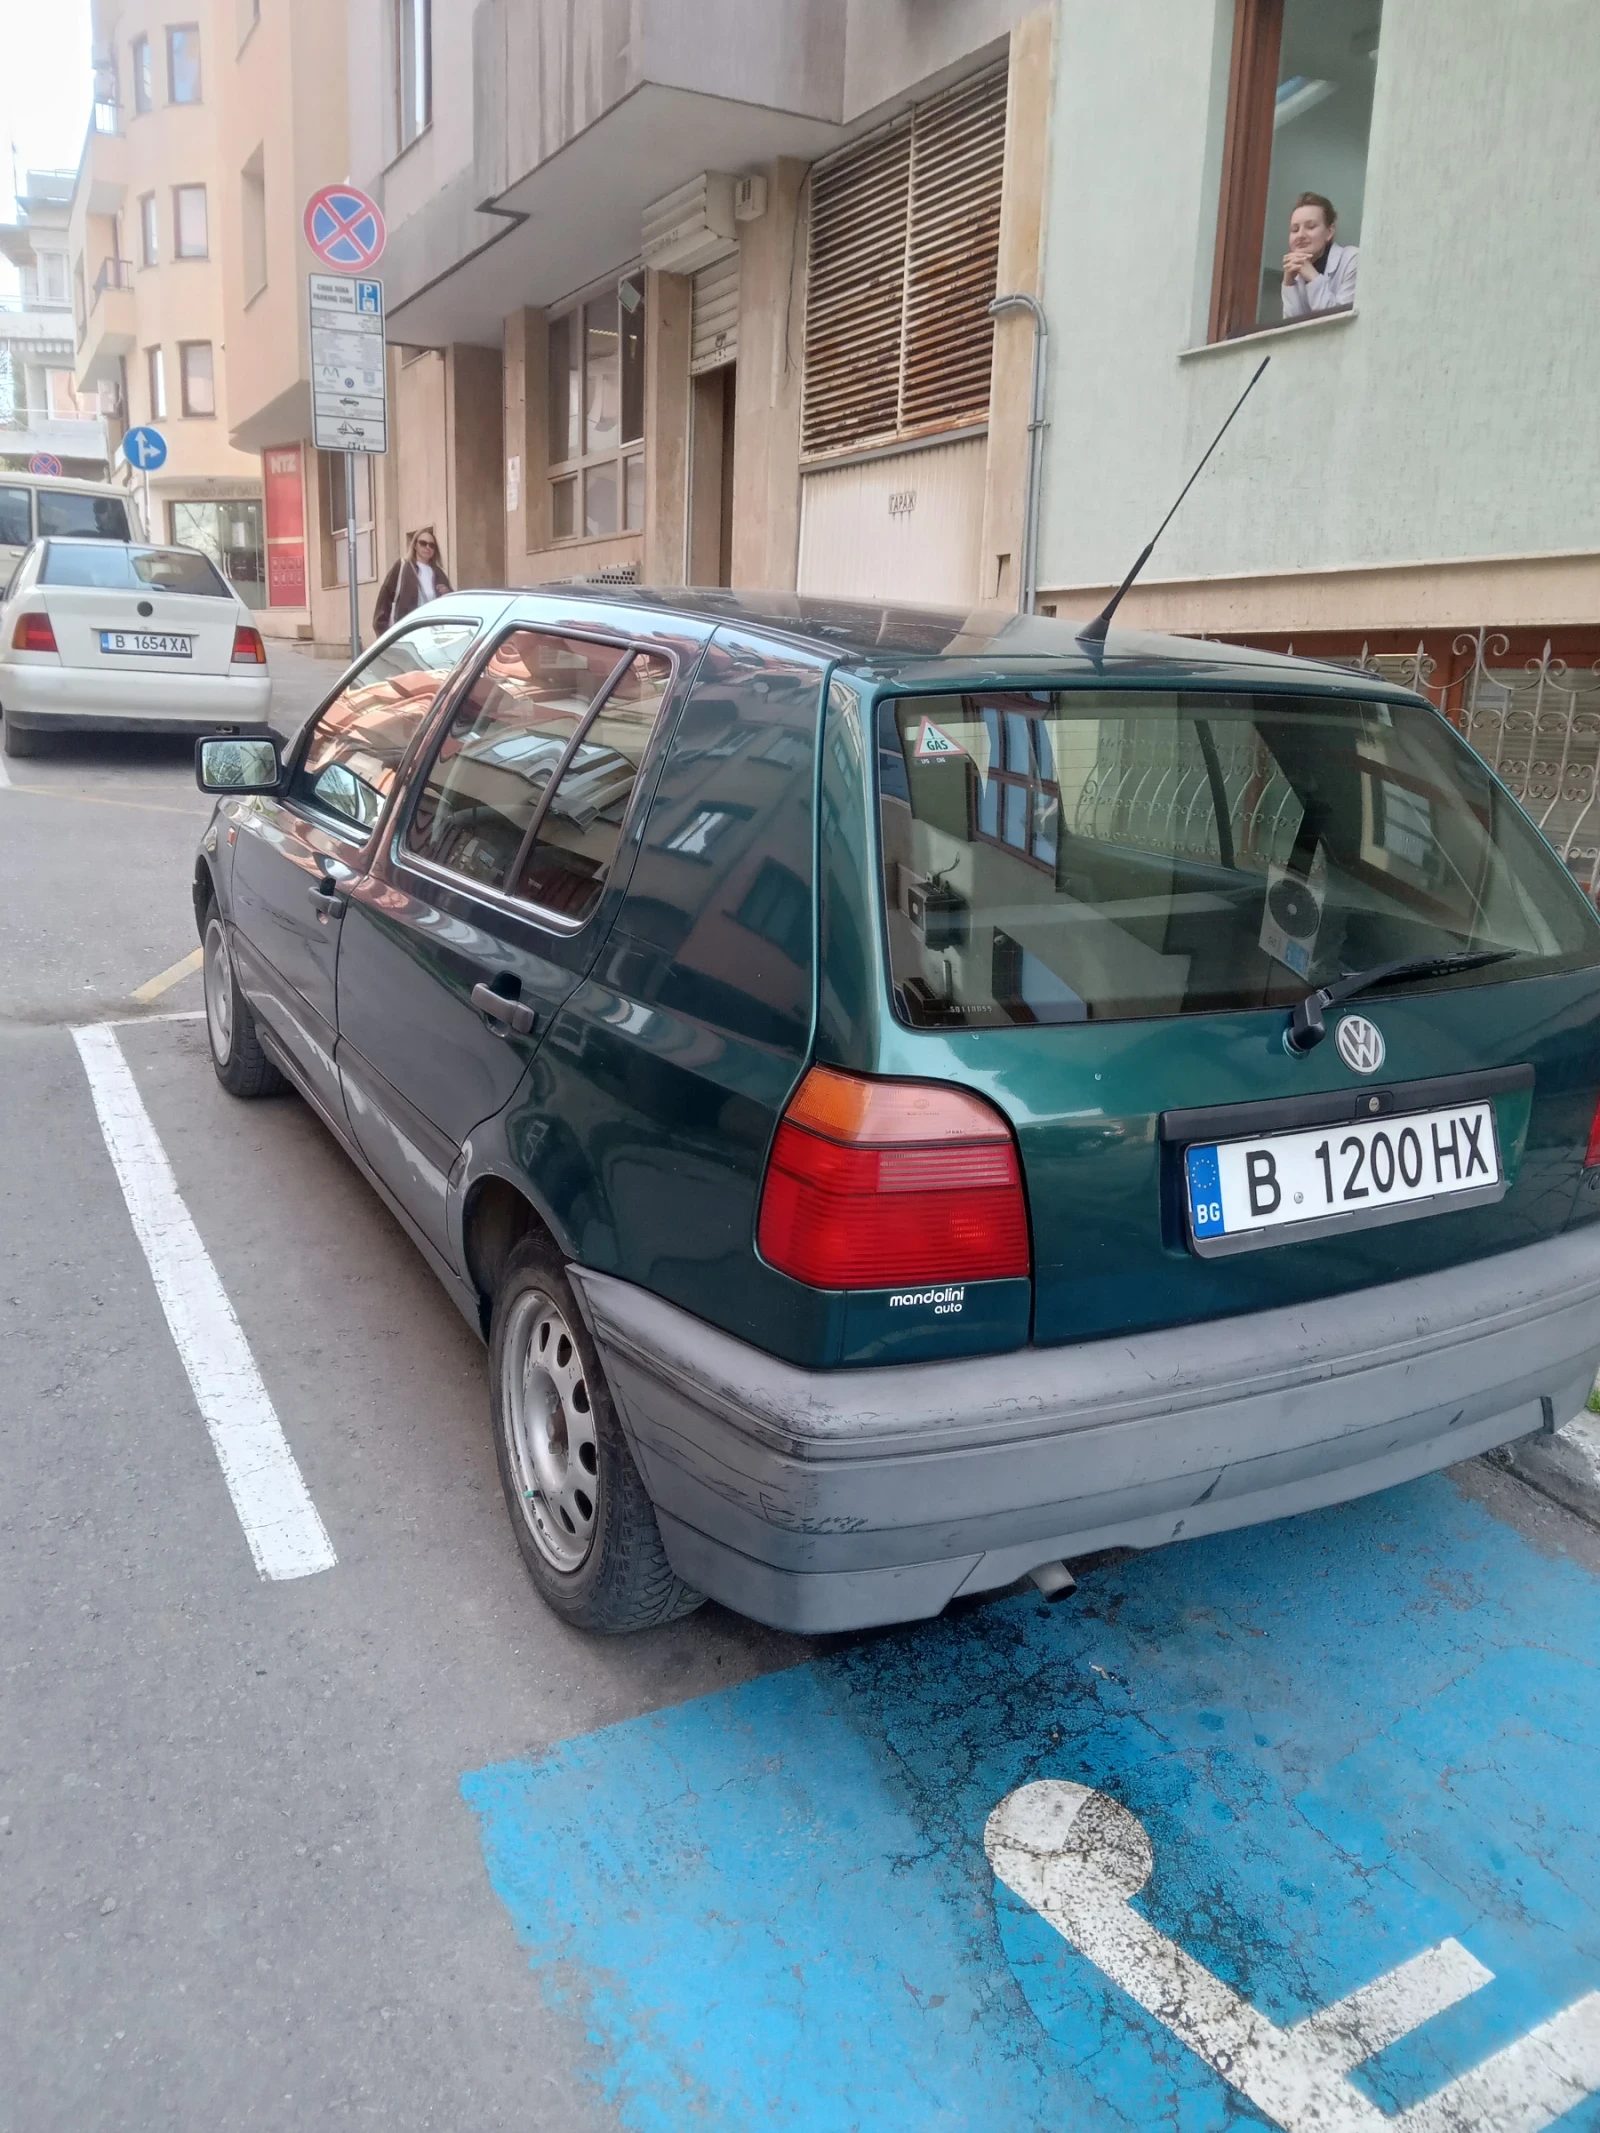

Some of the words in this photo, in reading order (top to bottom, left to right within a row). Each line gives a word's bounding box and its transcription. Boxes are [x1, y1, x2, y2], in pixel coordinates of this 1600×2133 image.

[312, 292, 338, 303] PARKING
[339, 296, 353, 304] ZONE
[363, 284, 373, 298] P
[270, 453, 297, 475] NTZ
[889, 493, 914, 511] ГАРАЖ
[115, 634, 126, 649] B
[926, 739, 949, 751] GAS
[1196, 1201, 1222, 1225] BG
[1245, 1149, 1282, 1217] B
[889, 1286, 965, 1307] mandolini
[934, 1303, 963, 1315] auto
